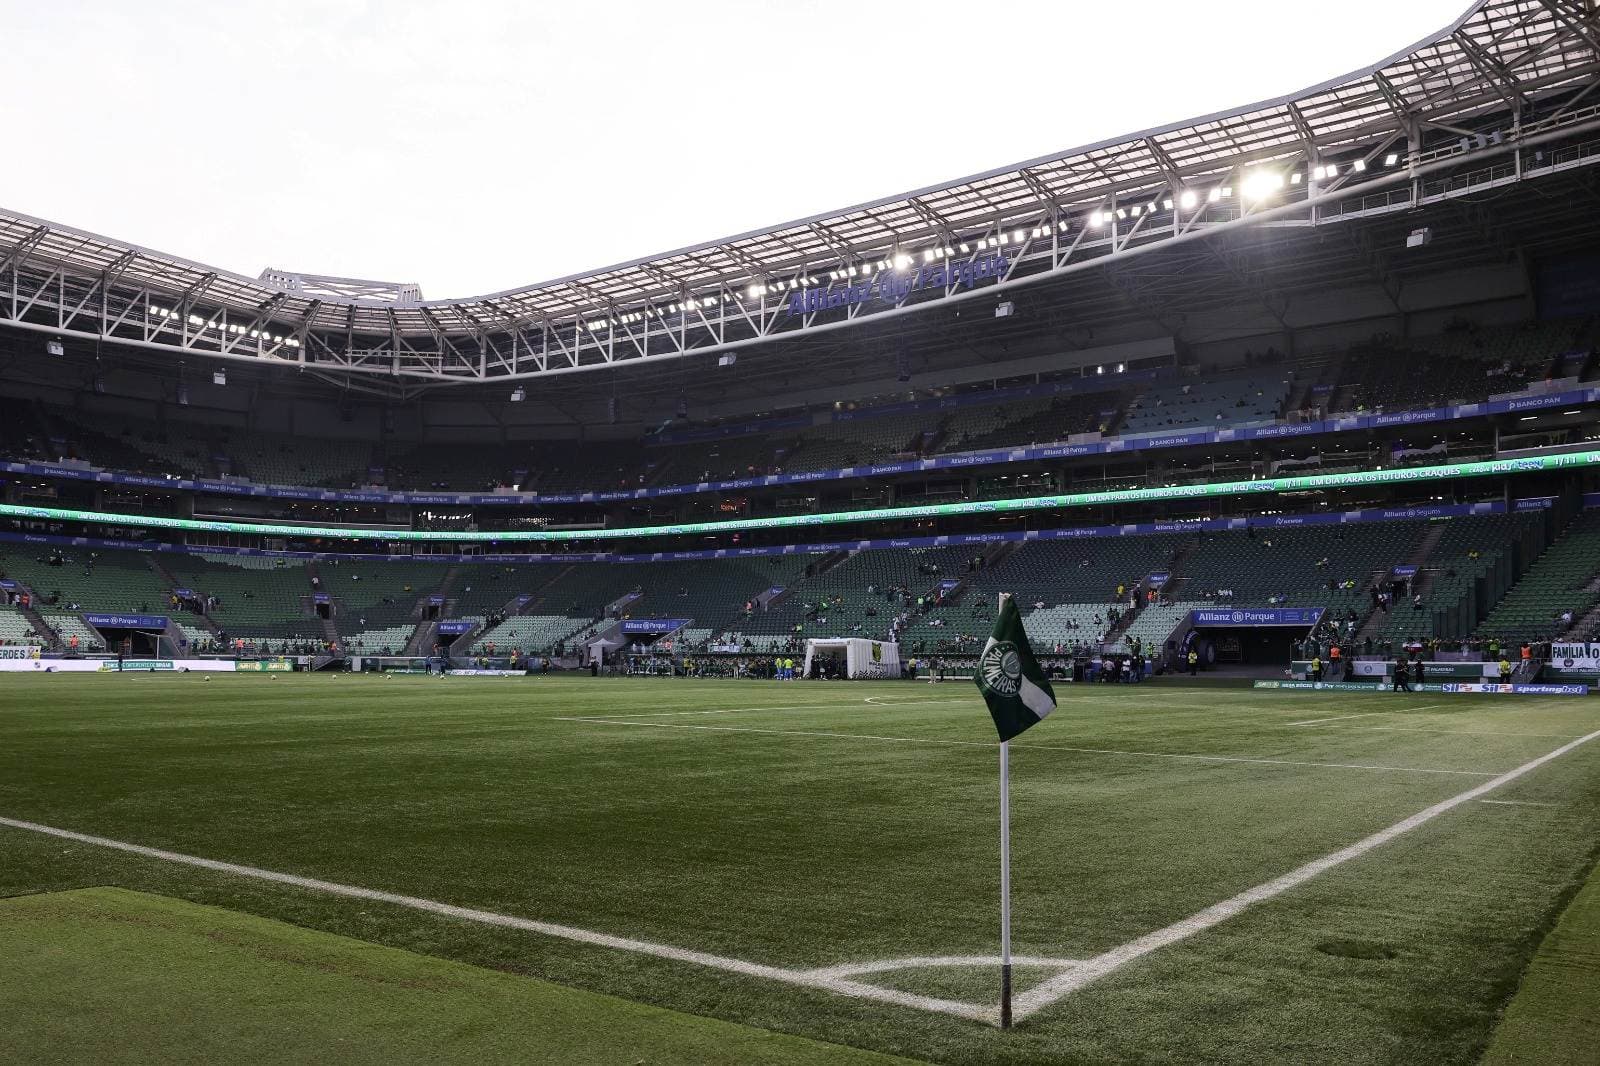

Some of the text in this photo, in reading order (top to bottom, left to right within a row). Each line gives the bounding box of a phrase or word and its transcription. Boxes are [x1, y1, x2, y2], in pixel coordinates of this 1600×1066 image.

[786, 255, 1008, 317] Allianz Parque
[1516, 397, 1561, 408] BANCO PAN
[1376, 412, 1436, 424] Allianz Parque
[1256, 425, 1312, 436] Allianz Seguros
[1155, 439, 1174, 447] BANCO
[1043, 448, 1062, 456] Allianz
[1309, 478, 1324, 486] UM
[1325, 476, 1340, 485] DIA
[1342, 474, 1364, 483] PARA
[1366, 473, 1377, 482] OS
[1378, 470, 1418, 481] FUTUROS
[1419, 468, 1460, 478] CRAQUES
[1112, 492, 1129, 501] PARA
[1141, 490, 1173, 499] FUTUROS
[1174, 487, 1208, 497] CRAQUES
[1517, 501, 1541, 509] Allianz
[1416, 509, 1441, 517] Seguros
[88, 616, 138, 625] Allianz Parque
[1199, 612, 1230, 621] Allianz
[1244, 612, 1275, 623] Parque
[649, 622, 667, 630] Parque
[982, 647, 1018, 694] PALMEIRAS
